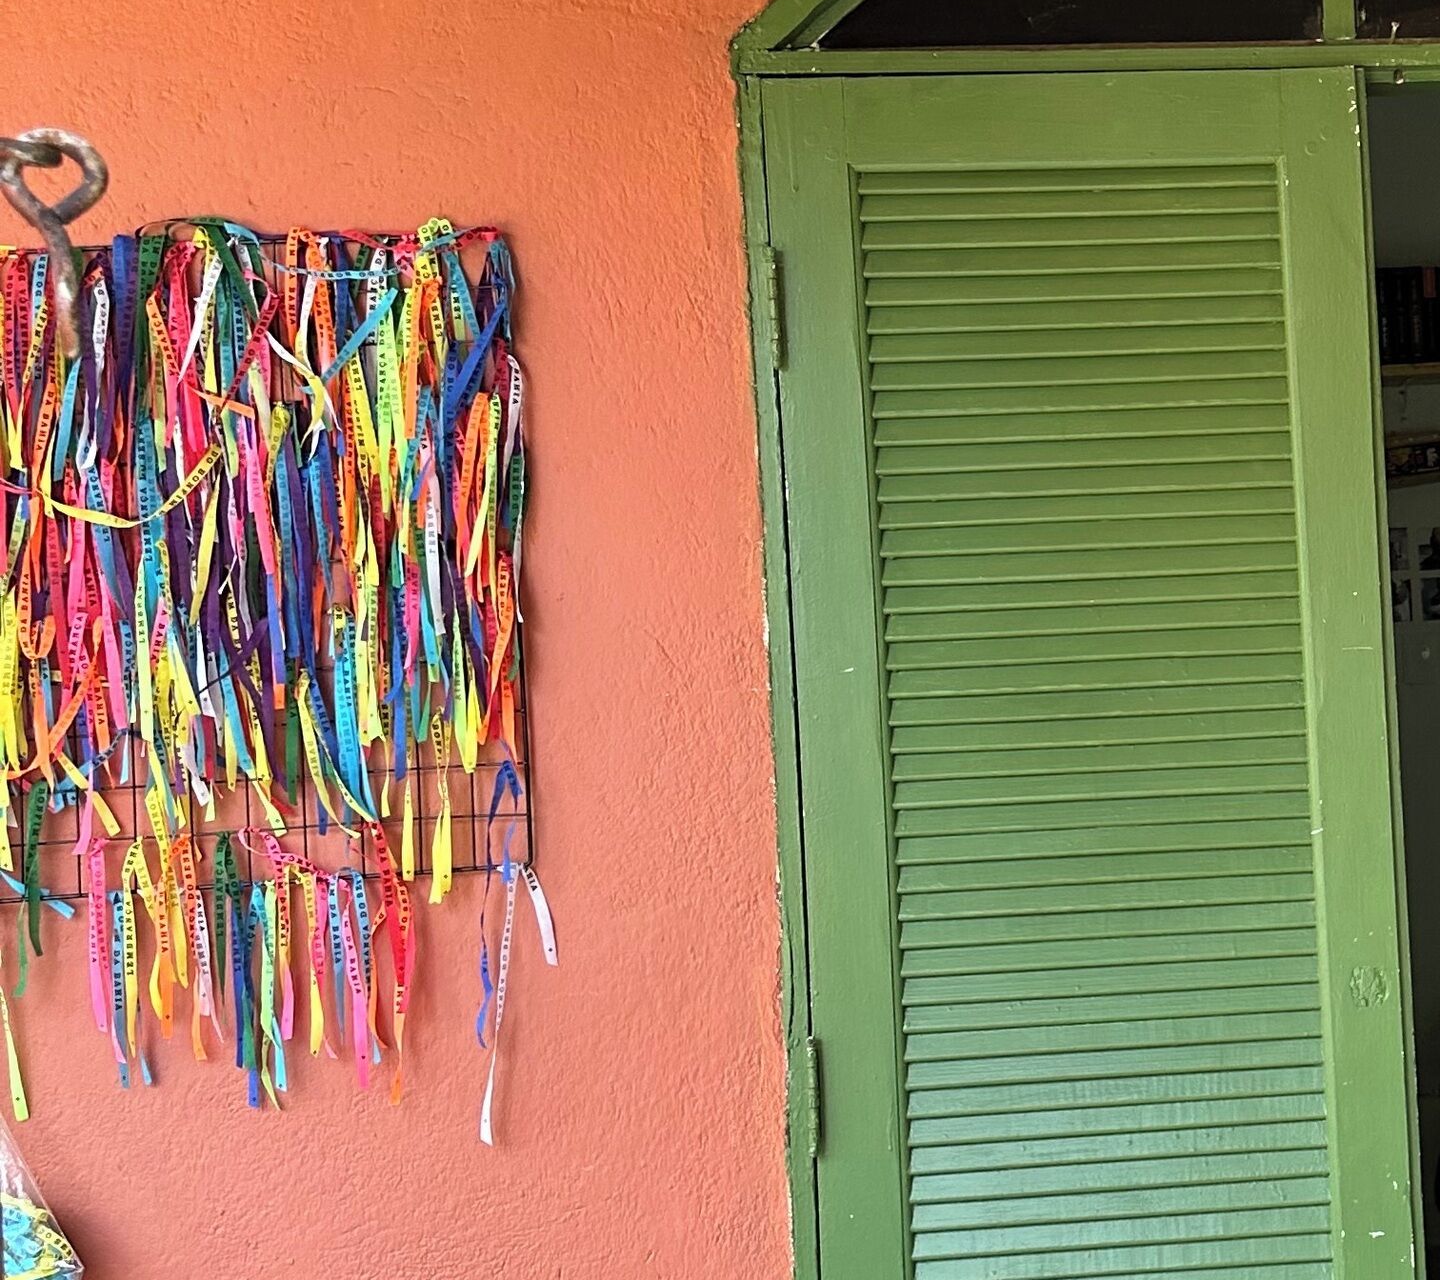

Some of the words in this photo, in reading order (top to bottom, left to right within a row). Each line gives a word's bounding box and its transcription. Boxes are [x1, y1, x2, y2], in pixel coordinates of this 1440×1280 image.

[6, 275, 14, 321] BONFIM
[35, 281, 43, 297] DO
[288, 287, 297, 325] BAHIA
[6, 329, 13, 344] DA
[6, 351, 14, 390] BAHIA
[512, 368, 520, 404] BAHIA
[46, 392, 54, 406] DA
[37, 413, 49, 450] BAHIA
[207, 451, 219, 464] DO
[360, 454, 367, 468] DA
[88, 468, 110, 542] LERANÇA
[169, 468, 206, 506] BONFIM
[140, 487, 152, 561] LEMBRANÇA
[84, 568, 96, 606] BAHIA
[21, 618, 28, 633] DA
[150, 623, 165, 662] BAHIA
[231, 617, 239, 631] DA
[95, 687, 105, 725] BAHIA
[343, 671, 352, 706] BAHIA
[313, 695, 330, 733] BAHIA
[33, 787, 46, 836] BONFIM
[187, 884, 195, 900] DO
[378, 847, 387, 863] DA
[383, 869, 393, 907] BAHIA
[216, 860, 224, 937] LEMBRANÇA
[330, 904, 337, 918] DA
[358, 902, 367, 918] DO
[125, 901, 134, 975] LEMBRANÇA
[159, 914, 168, 953] BAHIA
[332, 926, 342, 964] BAHIA
[113, 950, 120, 965] DA
[346, 935, 353, 950] DA
[350, 958, 361, 994] BAHIA
[113, 972, 122, 1010] BAHIA
